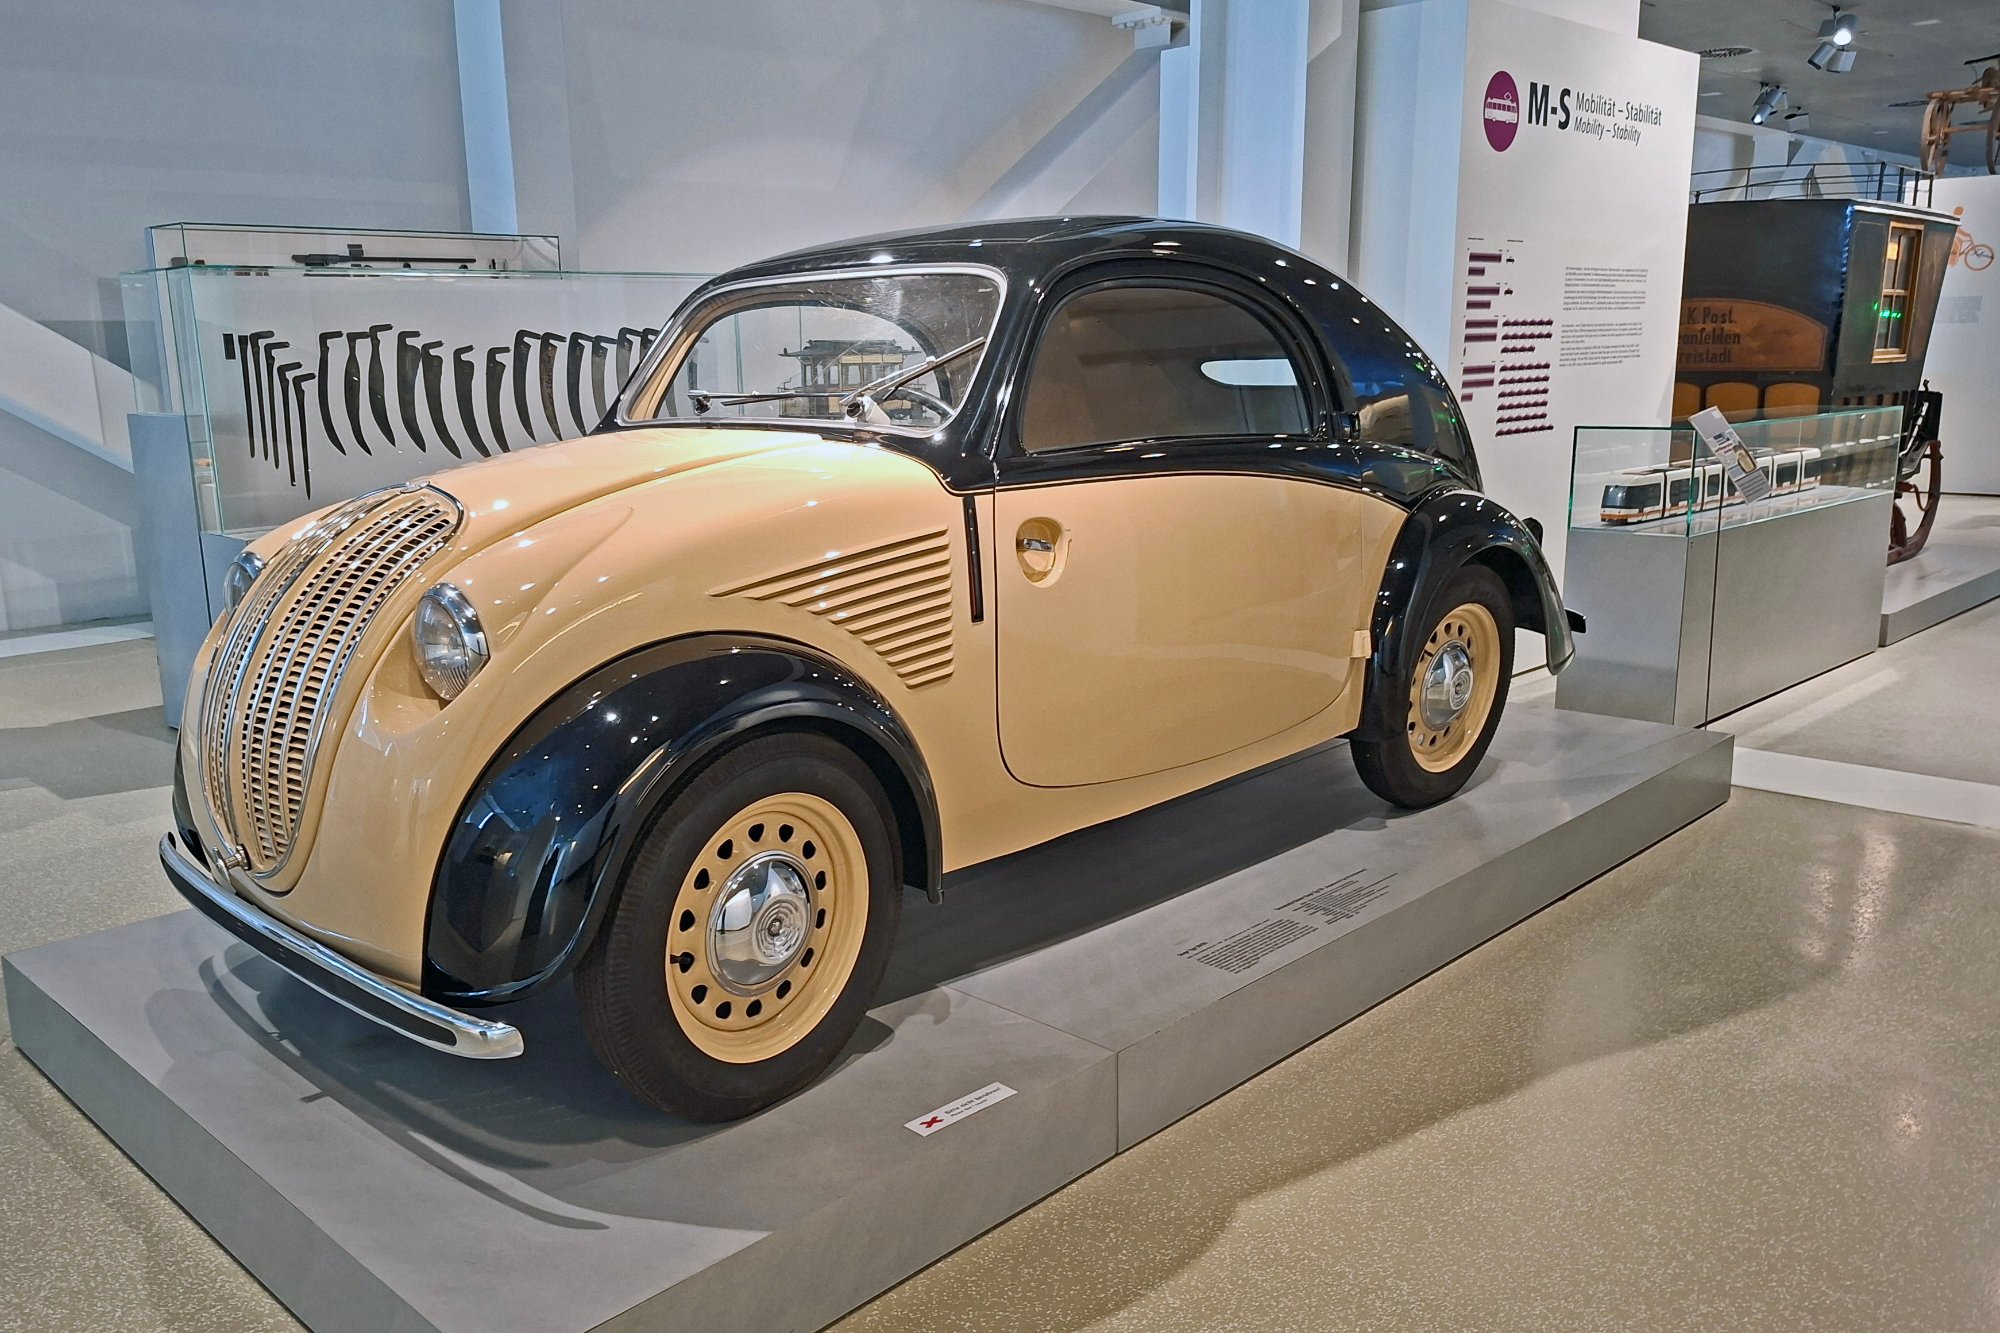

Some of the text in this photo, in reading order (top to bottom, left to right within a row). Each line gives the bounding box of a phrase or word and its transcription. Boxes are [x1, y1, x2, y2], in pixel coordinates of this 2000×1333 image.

[1528, 82, 1571, 130] M-S
[1576, 91, 1616, 118] Mobilität
[1625, 101, 1662, 126] Stabilität
[1574, 116, 1605, 140] Mobility
[1612, 123, 1642, 146] Stability
[1679, 327, 1741, 345] onfelden
[1680, 347, 1734, 364] reistadt
